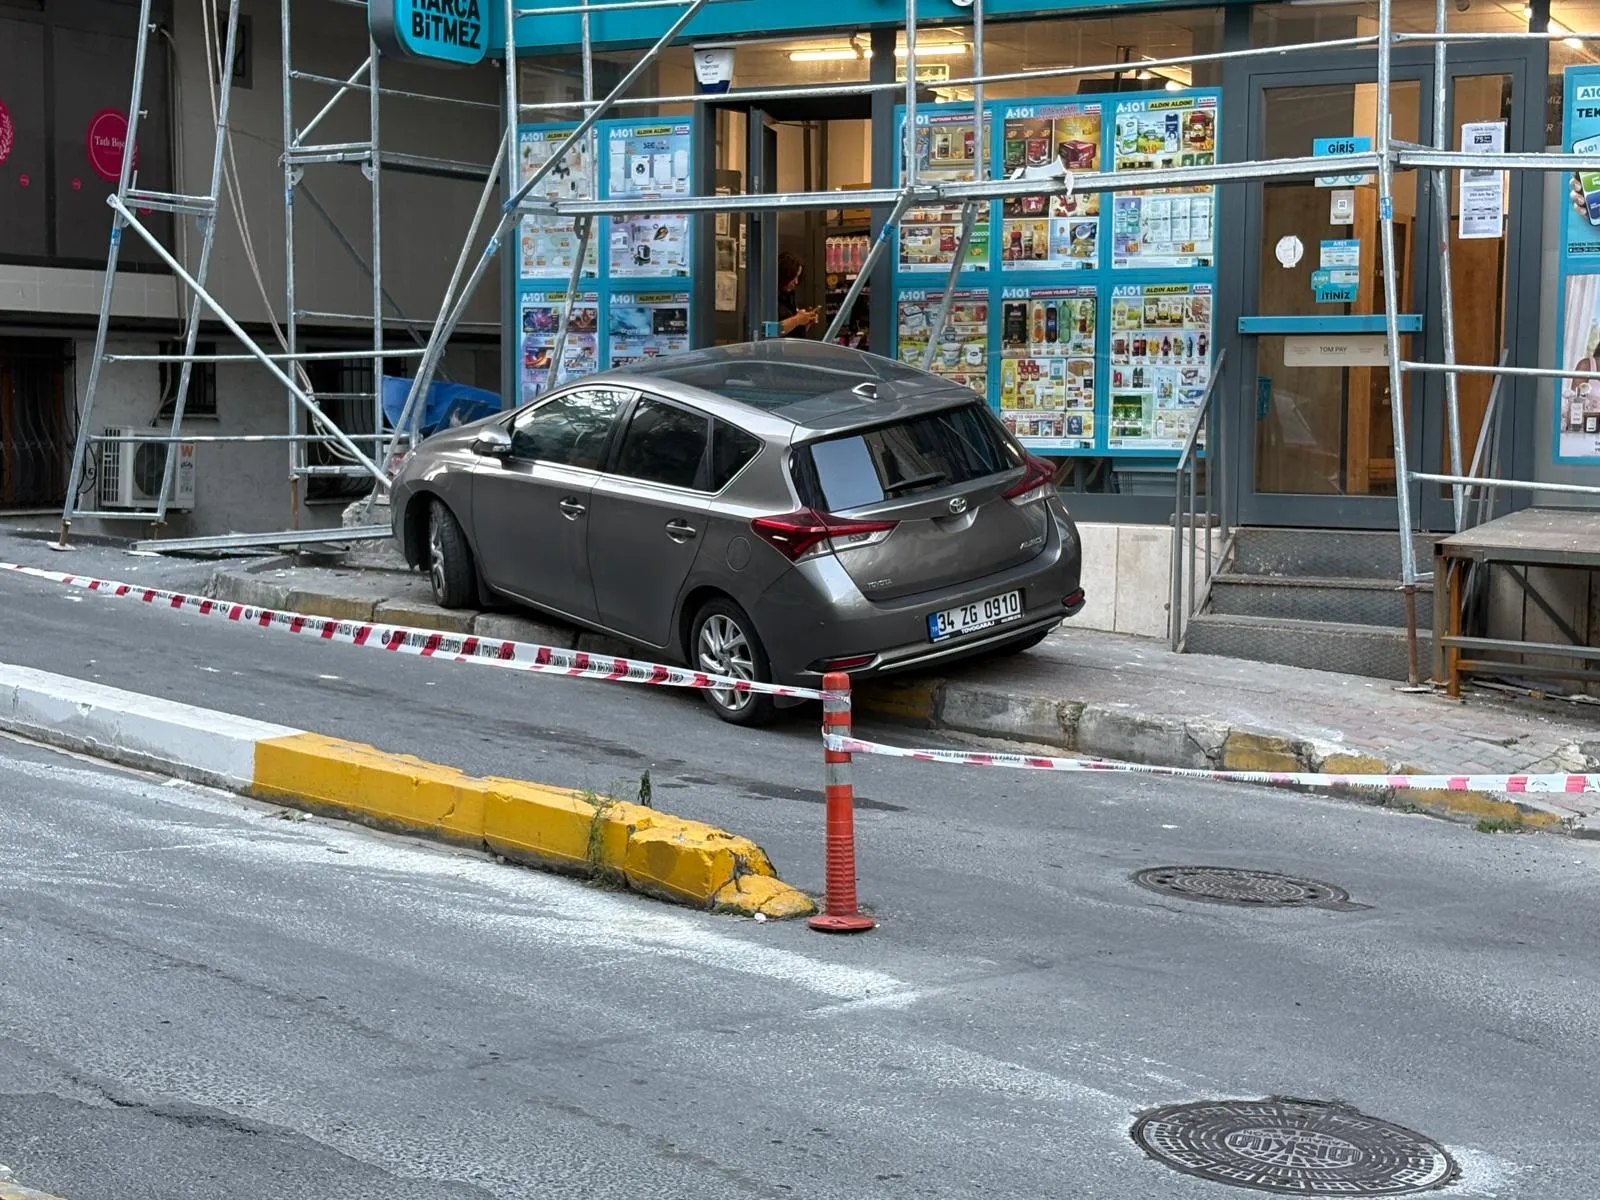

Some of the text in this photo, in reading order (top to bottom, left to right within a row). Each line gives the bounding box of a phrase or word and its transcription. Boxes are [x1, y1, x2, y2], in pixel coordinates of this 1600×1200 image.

[1328, 141, 1355, 154] GİRİŞ
[1322, 290, 1351, 300] İTİNİZ
[938, 612, 955, 632] 34
[961, 605, 978, 626] ZG
[984, 593, 1018, 619] 0910
